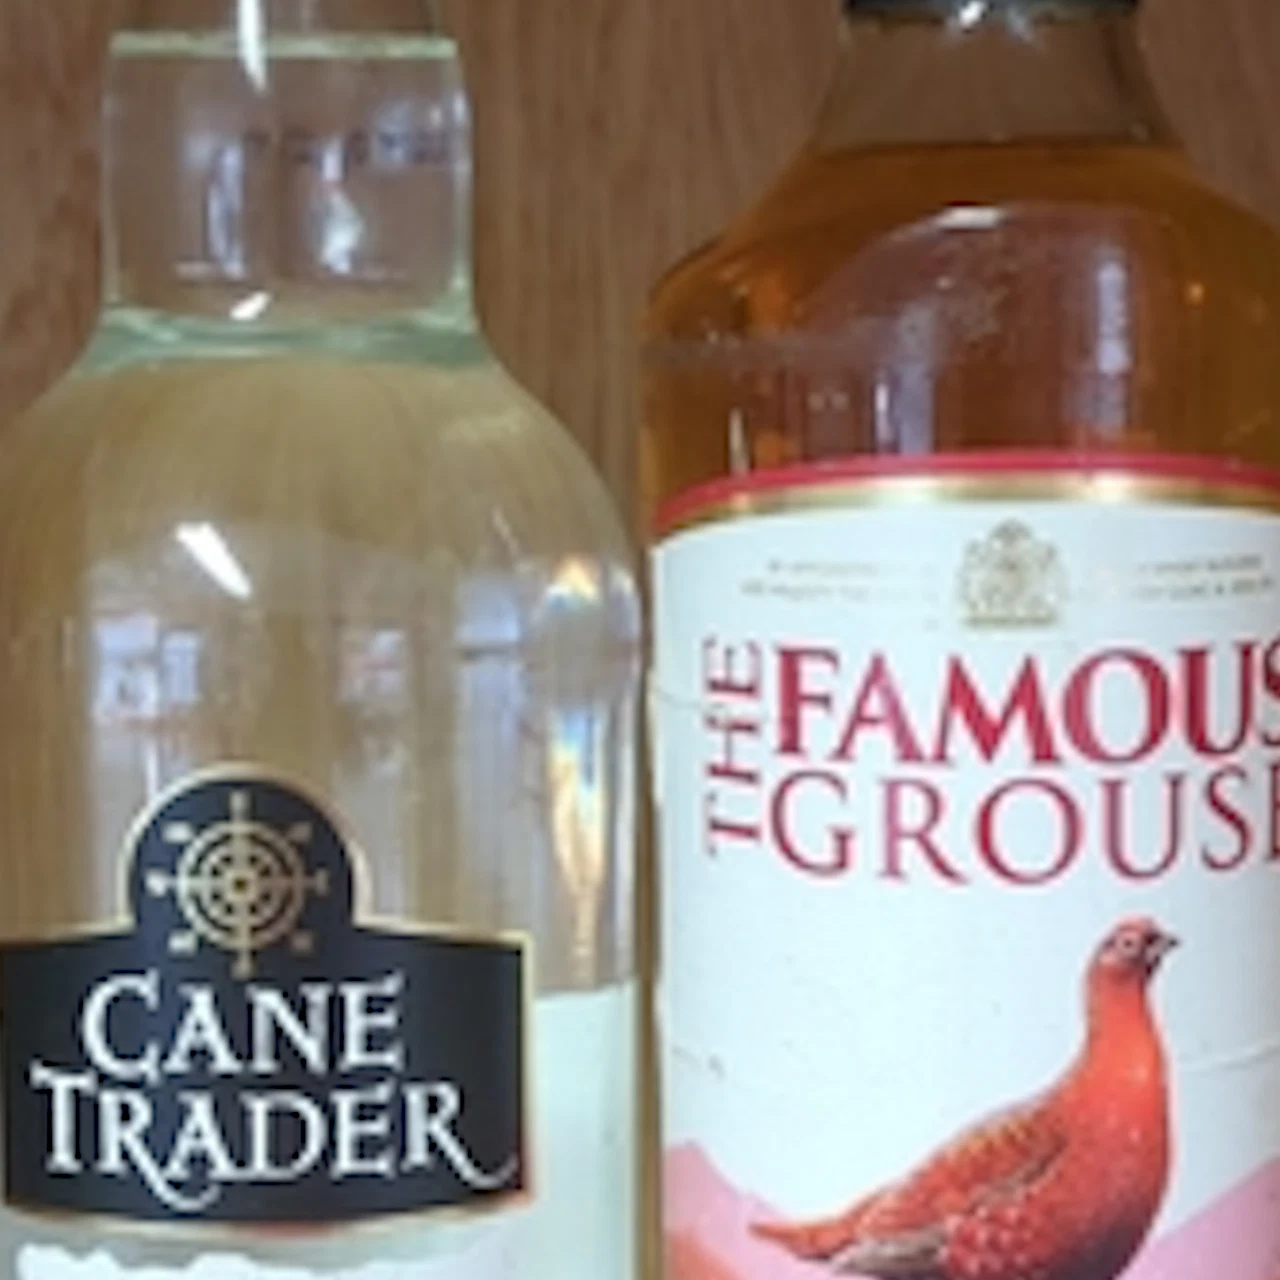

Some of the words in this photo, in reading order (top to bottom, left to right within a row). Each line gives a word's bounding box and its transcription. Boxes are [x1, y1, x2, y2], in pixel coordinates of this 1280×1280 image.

[705, 635, 762, 856] THE
[82, 970, 406, 1084] CANE
[27, 1058, 519, 1212] TRADER
